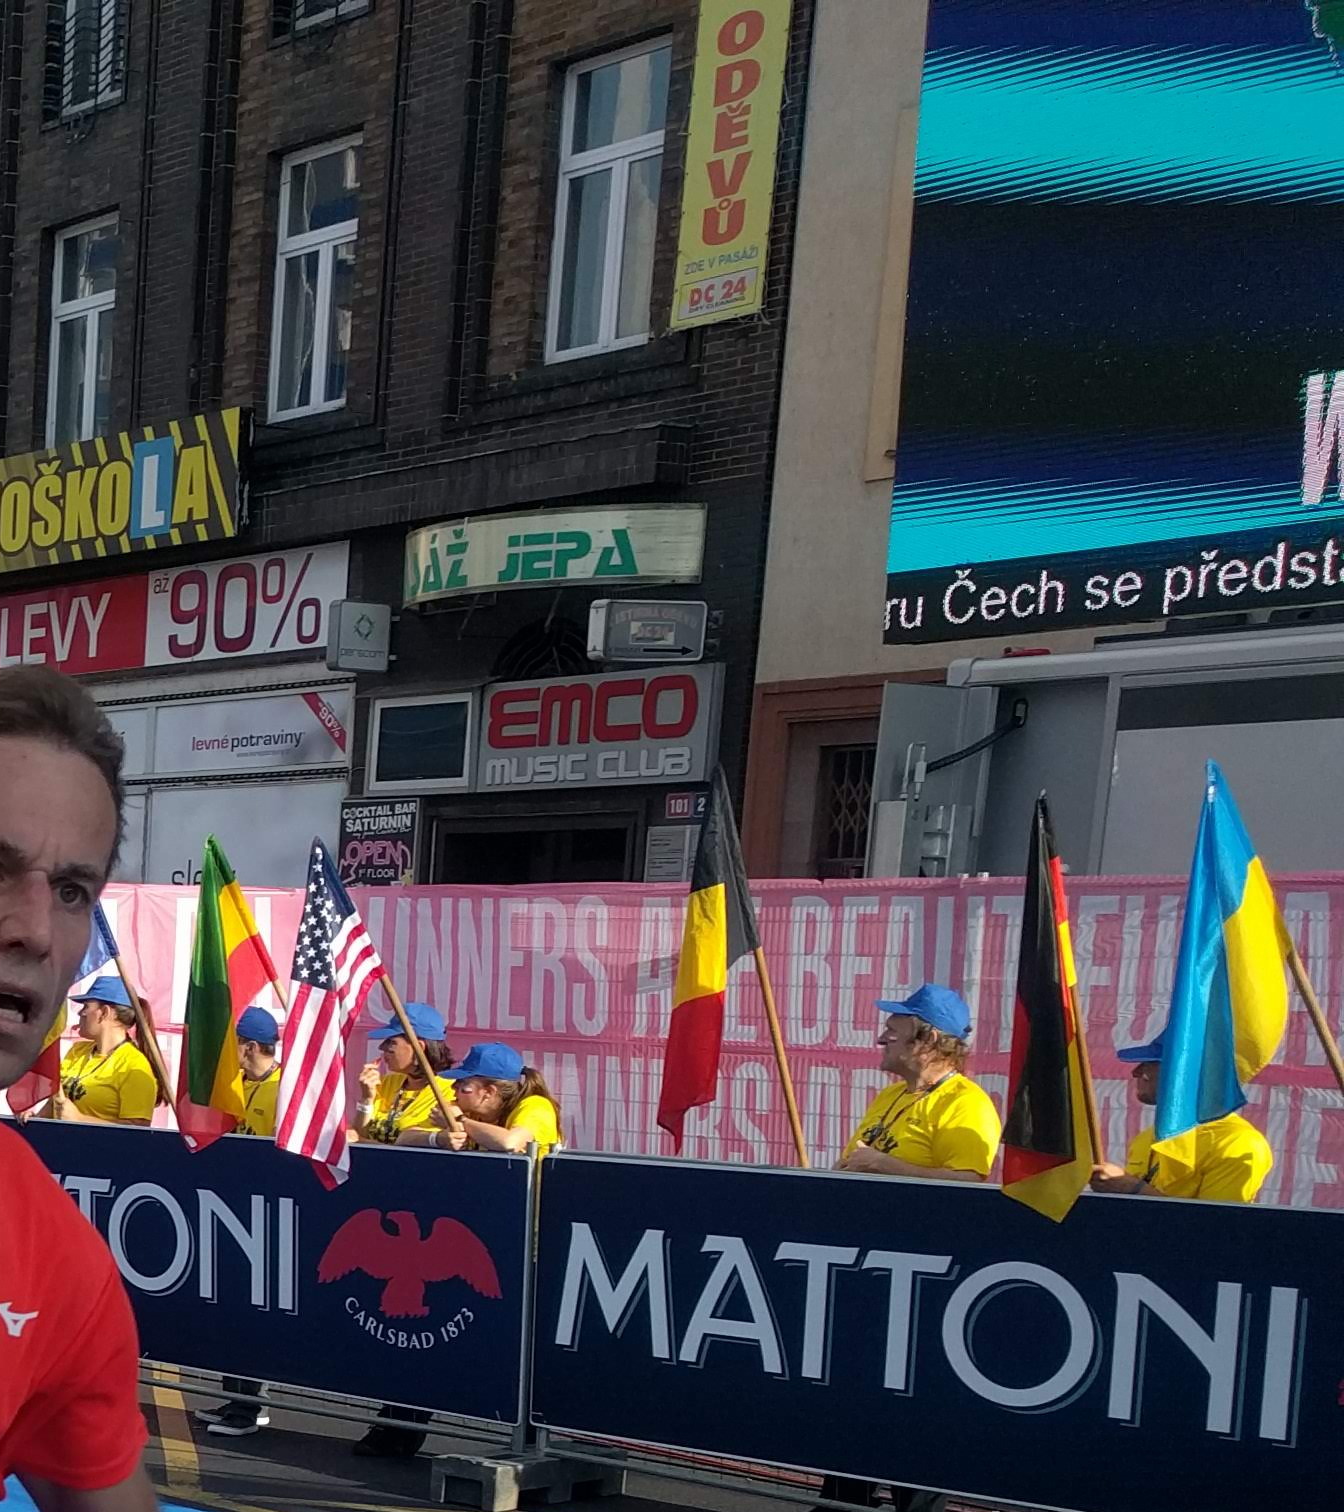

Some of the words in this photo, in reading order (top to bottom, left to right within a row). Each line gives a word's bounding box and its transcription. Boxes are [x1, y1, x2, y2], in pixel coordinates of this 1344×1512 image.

[702, 10, 766, 246] ODĚVŮ
[688, 283, 715, 308] DC
[721, 276, 747, 300] 24
[498, 527, 640, 583] JEPA
[153, 574, 170, 595] až
[168, 552, 322, 660] 90%
[941, 568, 1065, 624] Čech
[1084, 570, 1144, 612] se
[487, 673, 699, 750] EMCO
[192, 734, 230, 752] levné
[230, 728, 303, 753] potraviny
[486, 752, 588, 787] MUSIC
[596, 746, 692, 780] CLUB
[342, 804, 393, 819] COCKTAIL
[394, 802, 417, 814] BAR
[345, 814, 412, 832] SATURNIN
[669, 797, 690, 814] 101
[345, 840, 404, 866] OPEN
[367, 868, 396, 878] FLOOR
[366, 895, 611, 1037] UNNERS
[632, 896, 762, 1042] AE
[47, 1170, 302, 1318] TONI
[343, 1295, 436, 1351] CARLSBAD
[438, 1306, 477, 1343] 1873
[554, 1221, 1306, 1448] MATTONI
